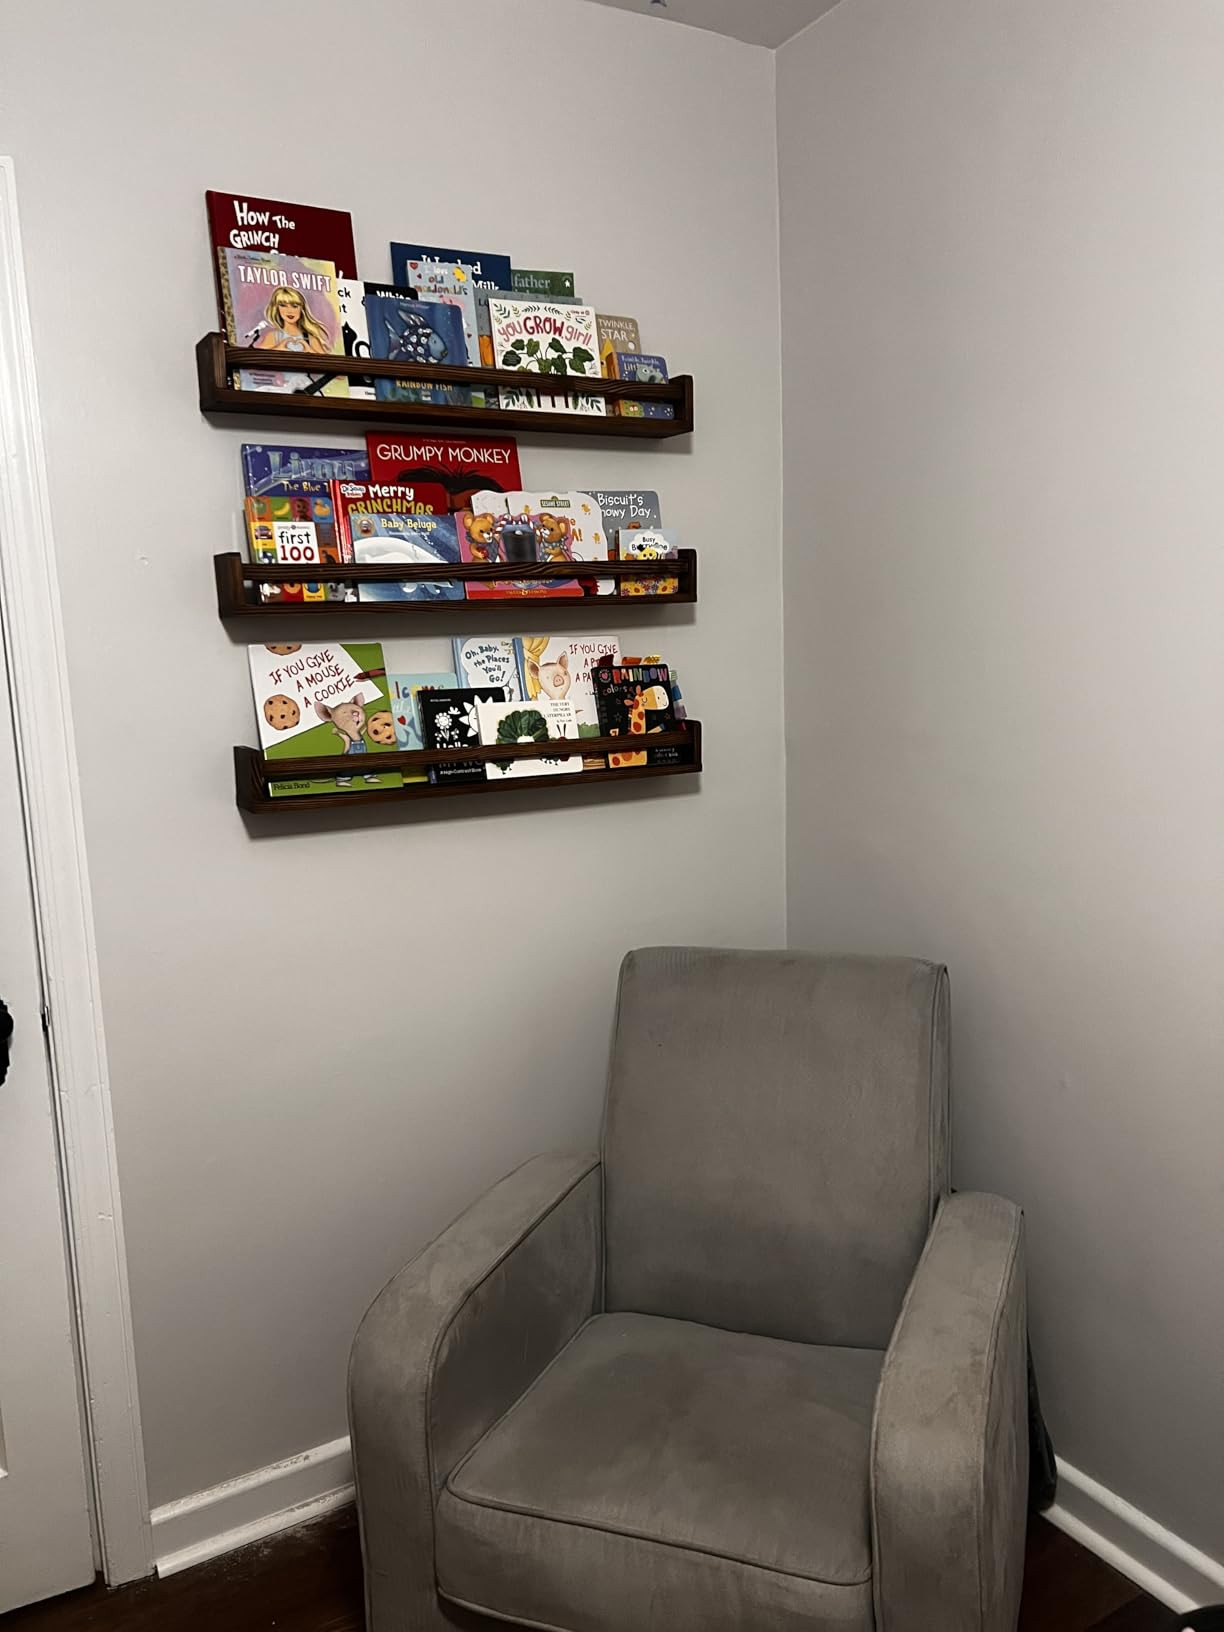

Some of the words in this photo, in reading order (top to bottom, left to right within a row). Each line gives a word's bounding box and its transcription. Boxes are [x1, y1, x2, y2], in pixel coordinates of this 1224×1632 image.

[233, 200, 270, 227] How
[272, 216, 296, 230] The
[230, 229, 280, 249] GRINCH
[238, 266, 288, 284] TAYLOR
[292, 272, 331, 292] SWIFT
[511, 273, 551, 289] father
[498, 319, 522, 341] you
[600, 328, 628, 341] STAR
[376, 443, 444, 462] GRUMPY
[448, 447, 511, 464] MONKEY
[282, 480, 299, 491] The
[303, 481, 321, 492] Blue
[368, 484, 415, 501] Merry
[347, 498, 434, 515] GRINCHMAS
[597, 493, 644, 506] Biscuit's
[602, 508, 626, 520] nowy
[630, 505, 651, 519] Day
[381, 518, 404, 531] Baby
[406, 518, 437, 532] Beluga
[278, 530, 311, 545] first
[280, 545, 315, 561] 100
[569, 643, 578, 655] IF
[579, 643, 596, 655] YOU
[597, 643, 619, 657] GIVE
[269, 668, 283, 686] IF
[283, 659, 305, 679] YOU
[305, 649, 335, 668] GIVE
[473, 658, 486, 669] the
[486, 654, 511, 666] Places
[482, 663, 502, 676] You'll
[583, 657, 589, 669] A
[295, 680, 304, 693] A
[304, 663, 345, 688] MOUSE
[488, 670, 506, 684] Go!
[575, 672, 581, 683] A
[612, 667, 668, 684] RAINBOW
[303, 696, 313, 708] A
[314, 674, 355, 702] COOKIE
